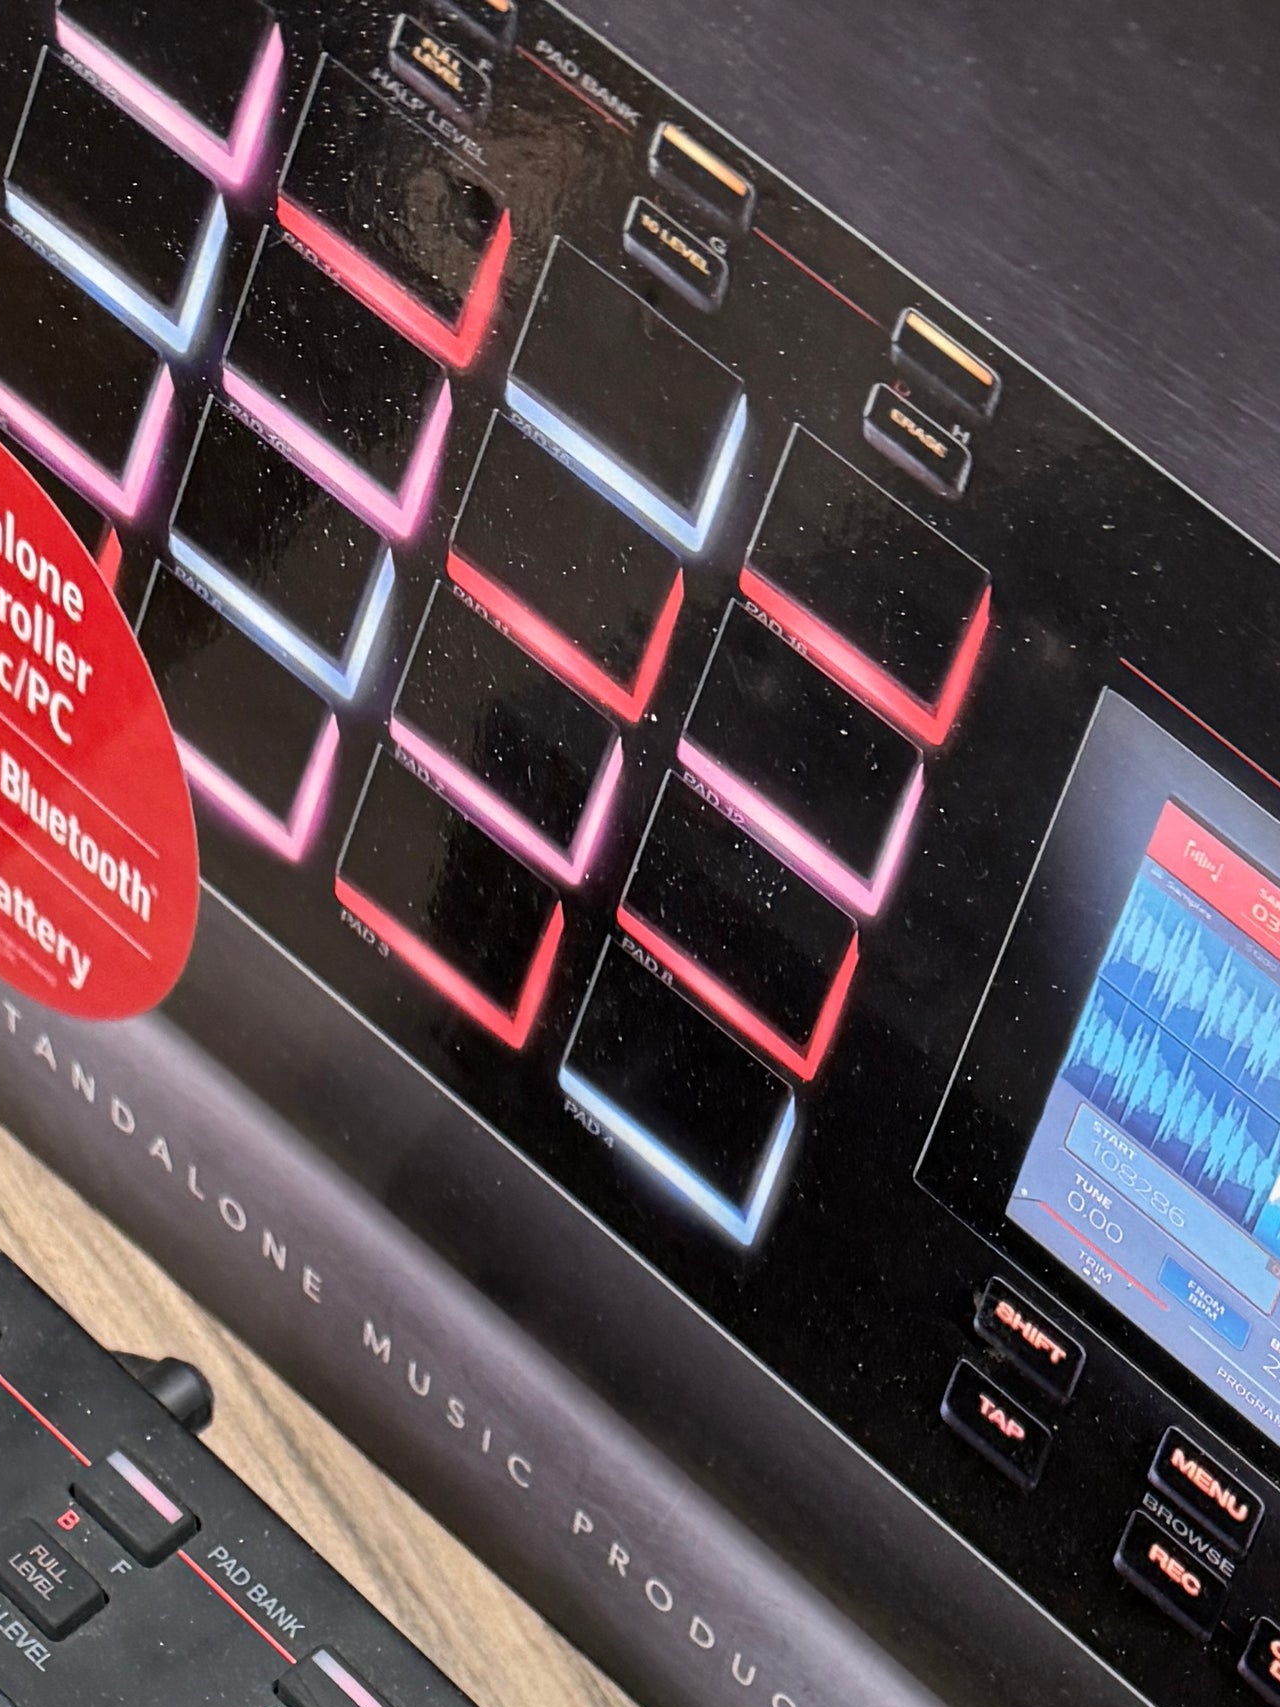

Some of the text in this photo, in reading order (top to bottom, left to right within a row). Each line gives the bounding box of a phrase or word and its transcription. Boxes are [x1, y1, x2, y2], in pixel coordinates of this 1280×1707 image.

[0, 752, 152, 923] Bluetooth
[1092, 1120, 1137, 1162] START
[1074, 1173, 1114, 1209] TUNE
[1091, 1139, 1186, 1229] 108286
[1067, 1190, 1124, 1244] 0.00
[994, 1300, 1069, 1366] SHIFT
[361, 1319, 534, 1492] MUSIC
[978, 1394, 1026, 1442] TAP
[1169, 1447, 1250, 1524] MENU
[29, 1544, 68, 1584] FULL
[1141, 1492, 1237, 1580] BROWSE
[8, 1553, 56, 1602] LEVEL
[207, 1545, 307, 1640] PAD BANK
[1147, 1543, 1203, 1598] REC
